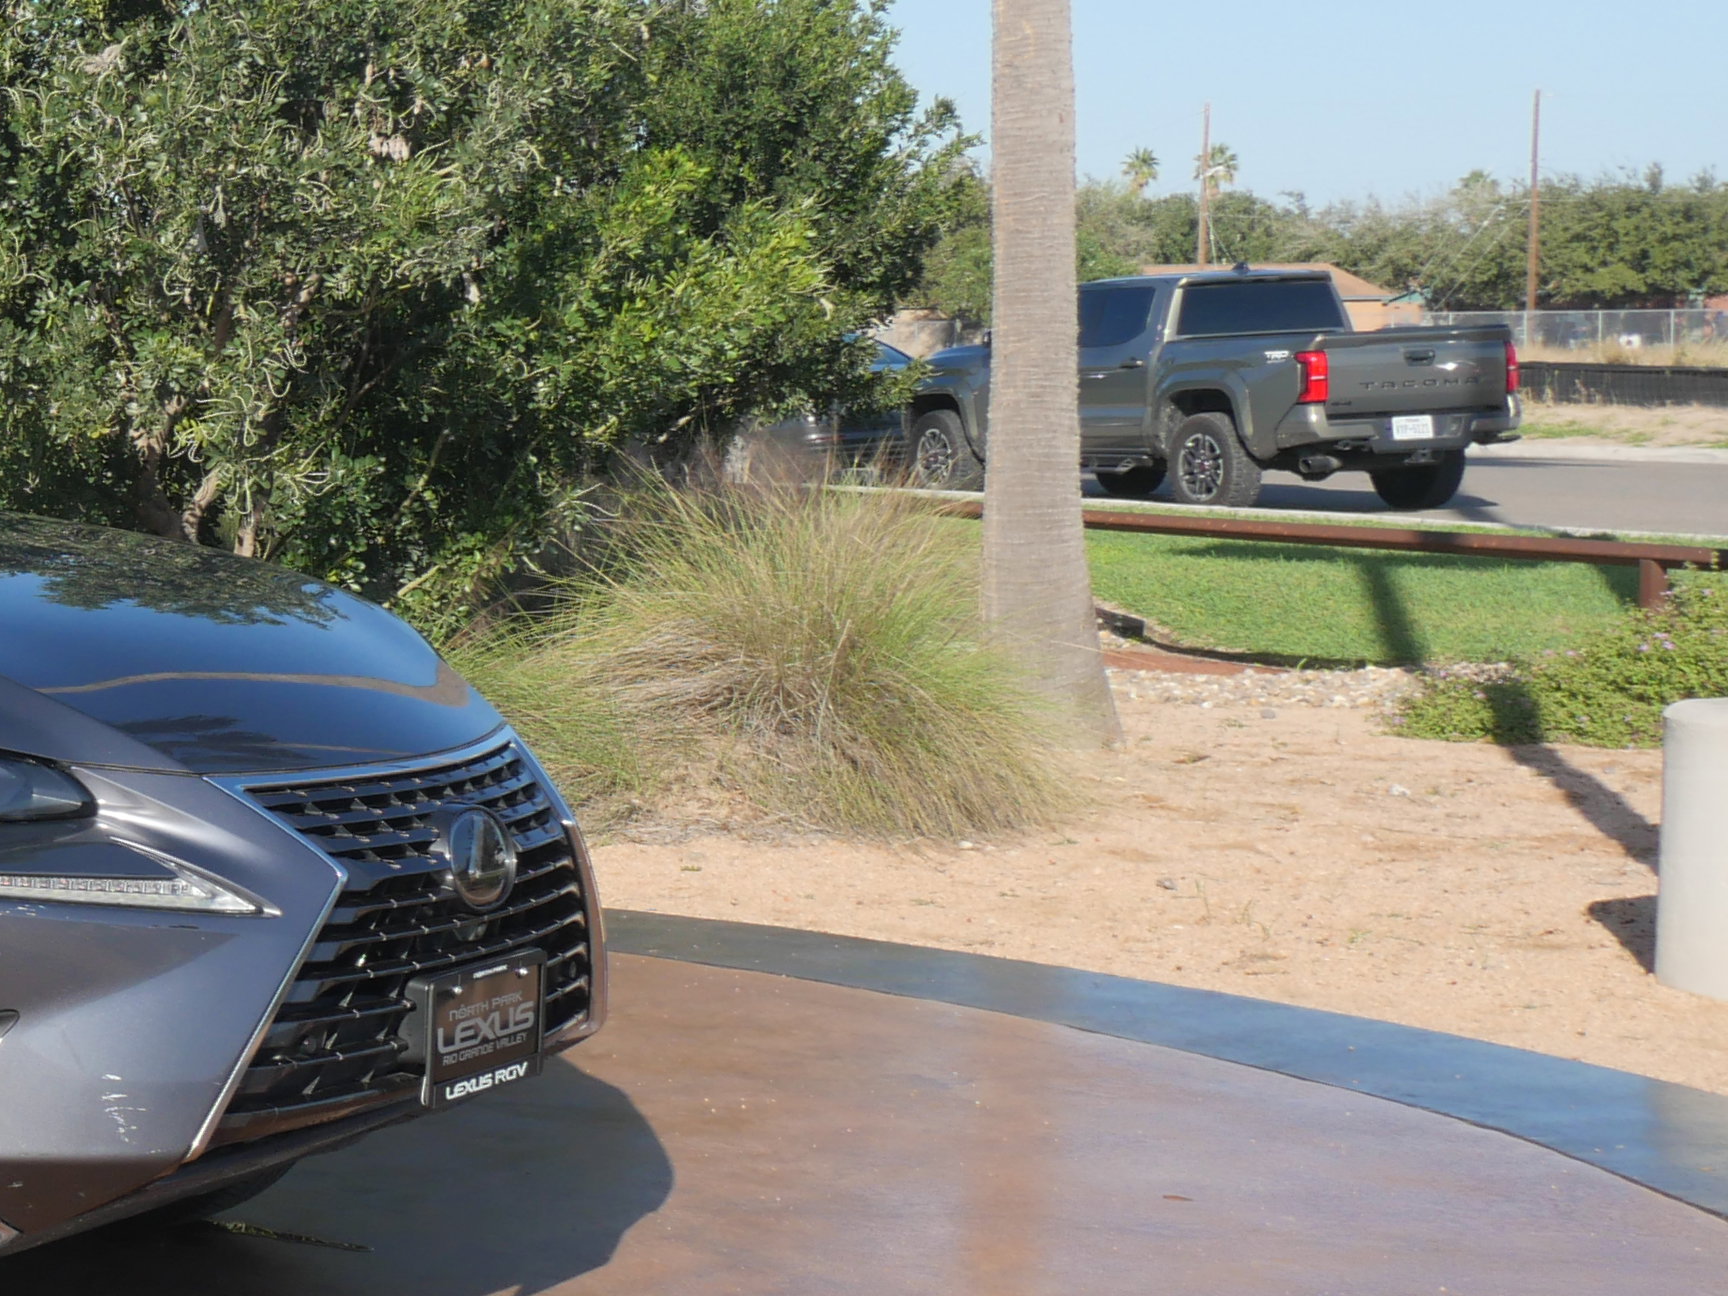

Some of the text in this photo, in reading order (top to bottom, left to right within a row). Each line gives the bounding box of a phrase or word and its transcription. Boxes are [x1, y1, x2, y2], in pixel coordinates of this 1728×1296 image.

[1359, 376, 1480, 391] TACOMA
[492, 991, 523, 1009] PARK
[437, 1000, 535, 1055] LEXUS
[443, 1032, 528, 1067] RIO GRANDE VALLEY
[446, 1061, 528, 1101] LEXUS RGV
